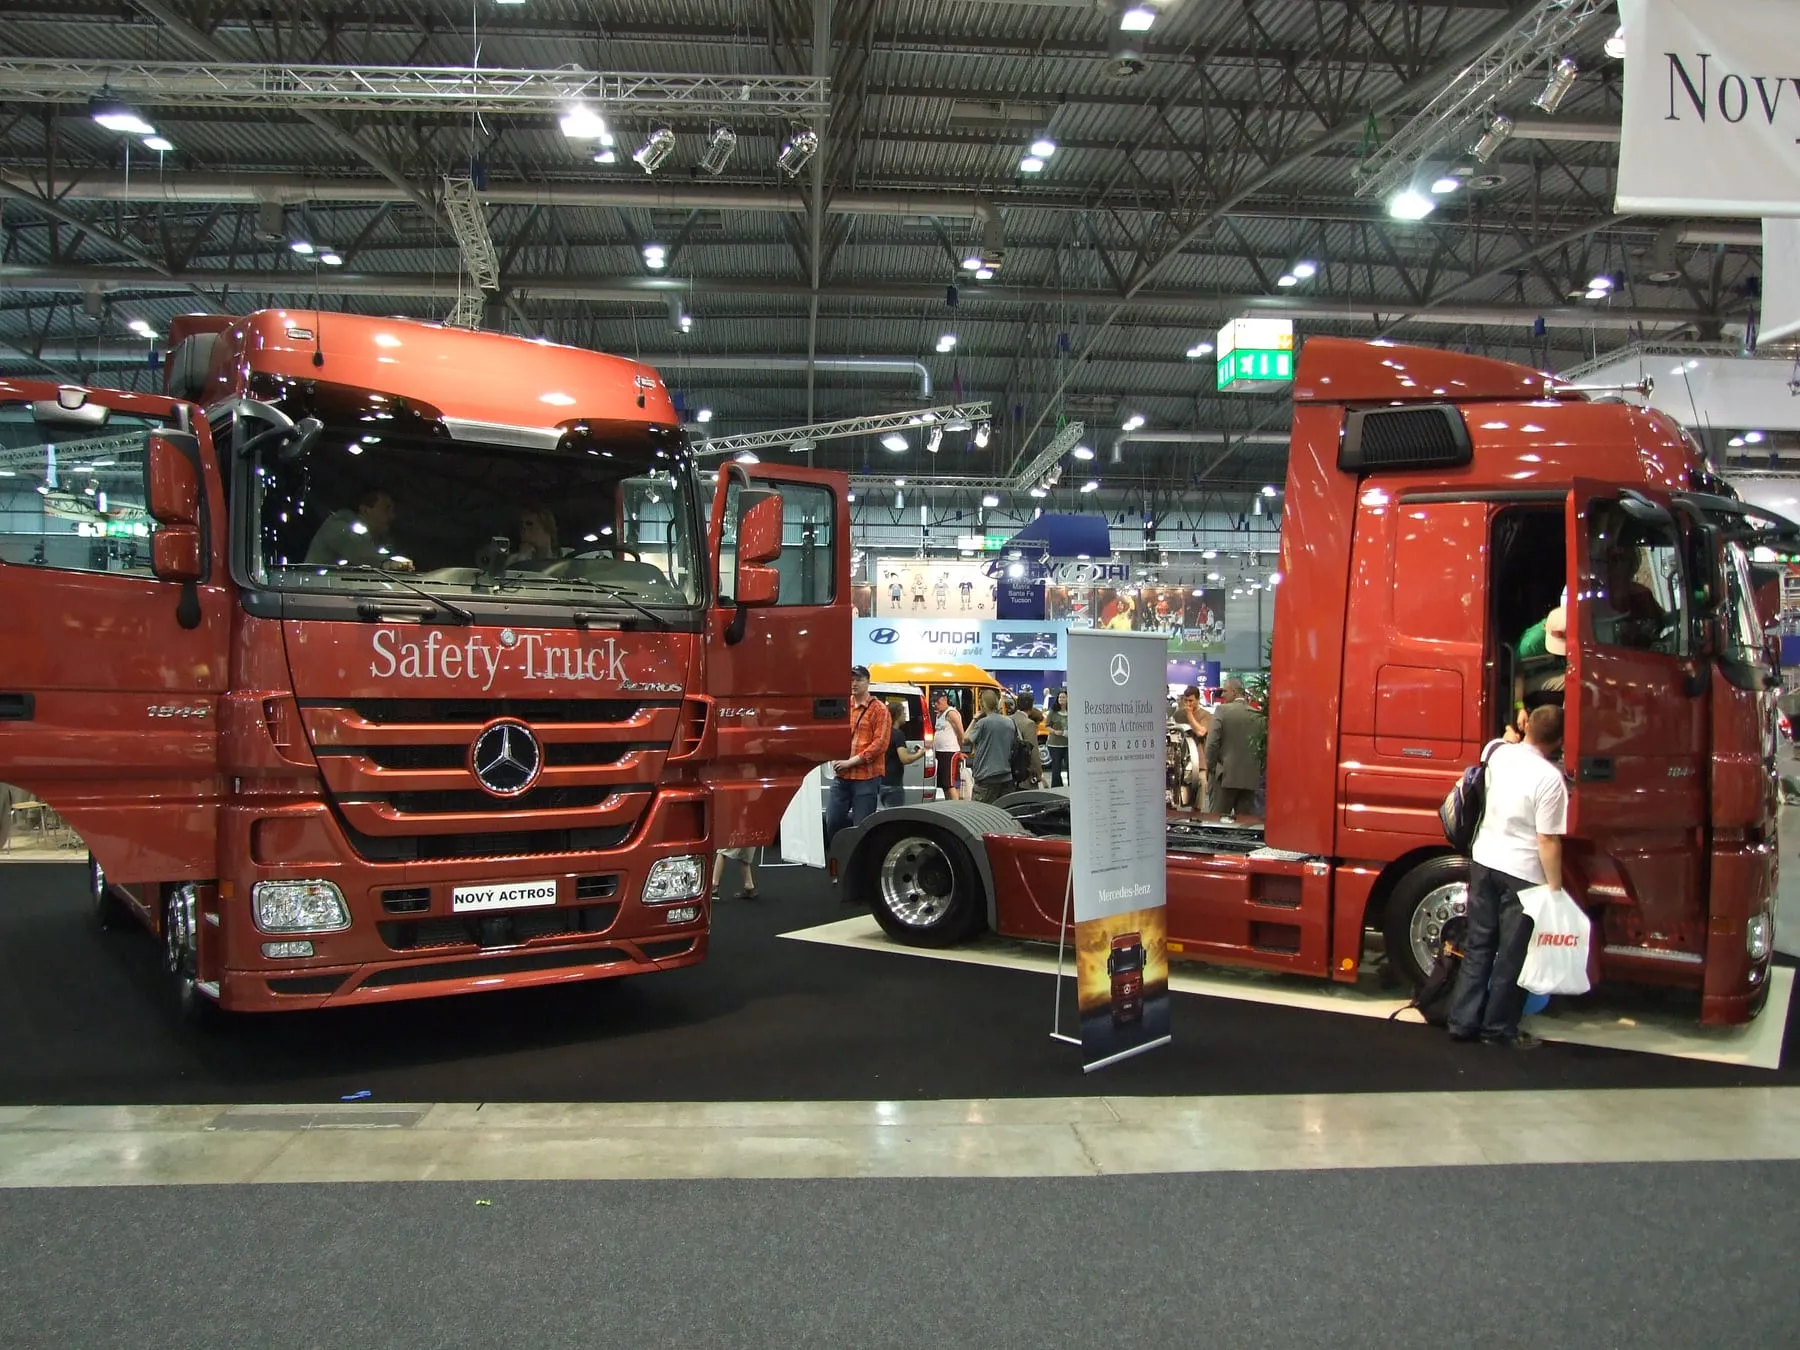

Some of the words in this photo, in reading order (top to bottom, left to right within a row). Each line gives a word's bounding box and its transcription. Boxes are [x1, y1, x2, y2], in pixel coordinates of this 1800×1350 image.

[915, 630, 981, 645] YUNDAI
[370, 628, 505, 692] Safety
[517, 634, 630, 681] Truck
[147, 705, 208, 718] 1844
[719, 707, 756, 718] 1844
[1084, 700, 1134, 715] Bezstarostná
[1135, 700, 1153, 718] jízda
[1084, 722, 1090, 734] s
[1091, 719, 1117, 737] novým
[1119, 719, 1155, 733] Actrosem
[1085, 740, 1118, 751] TOUR
[1126, 739, 1156, 750] 2008
[454, 889, 494, 905] NOVÝ
[498, 887, 555, 902] ACTROS
[1098, 883, 1152, 903] Mercedes-Benz
